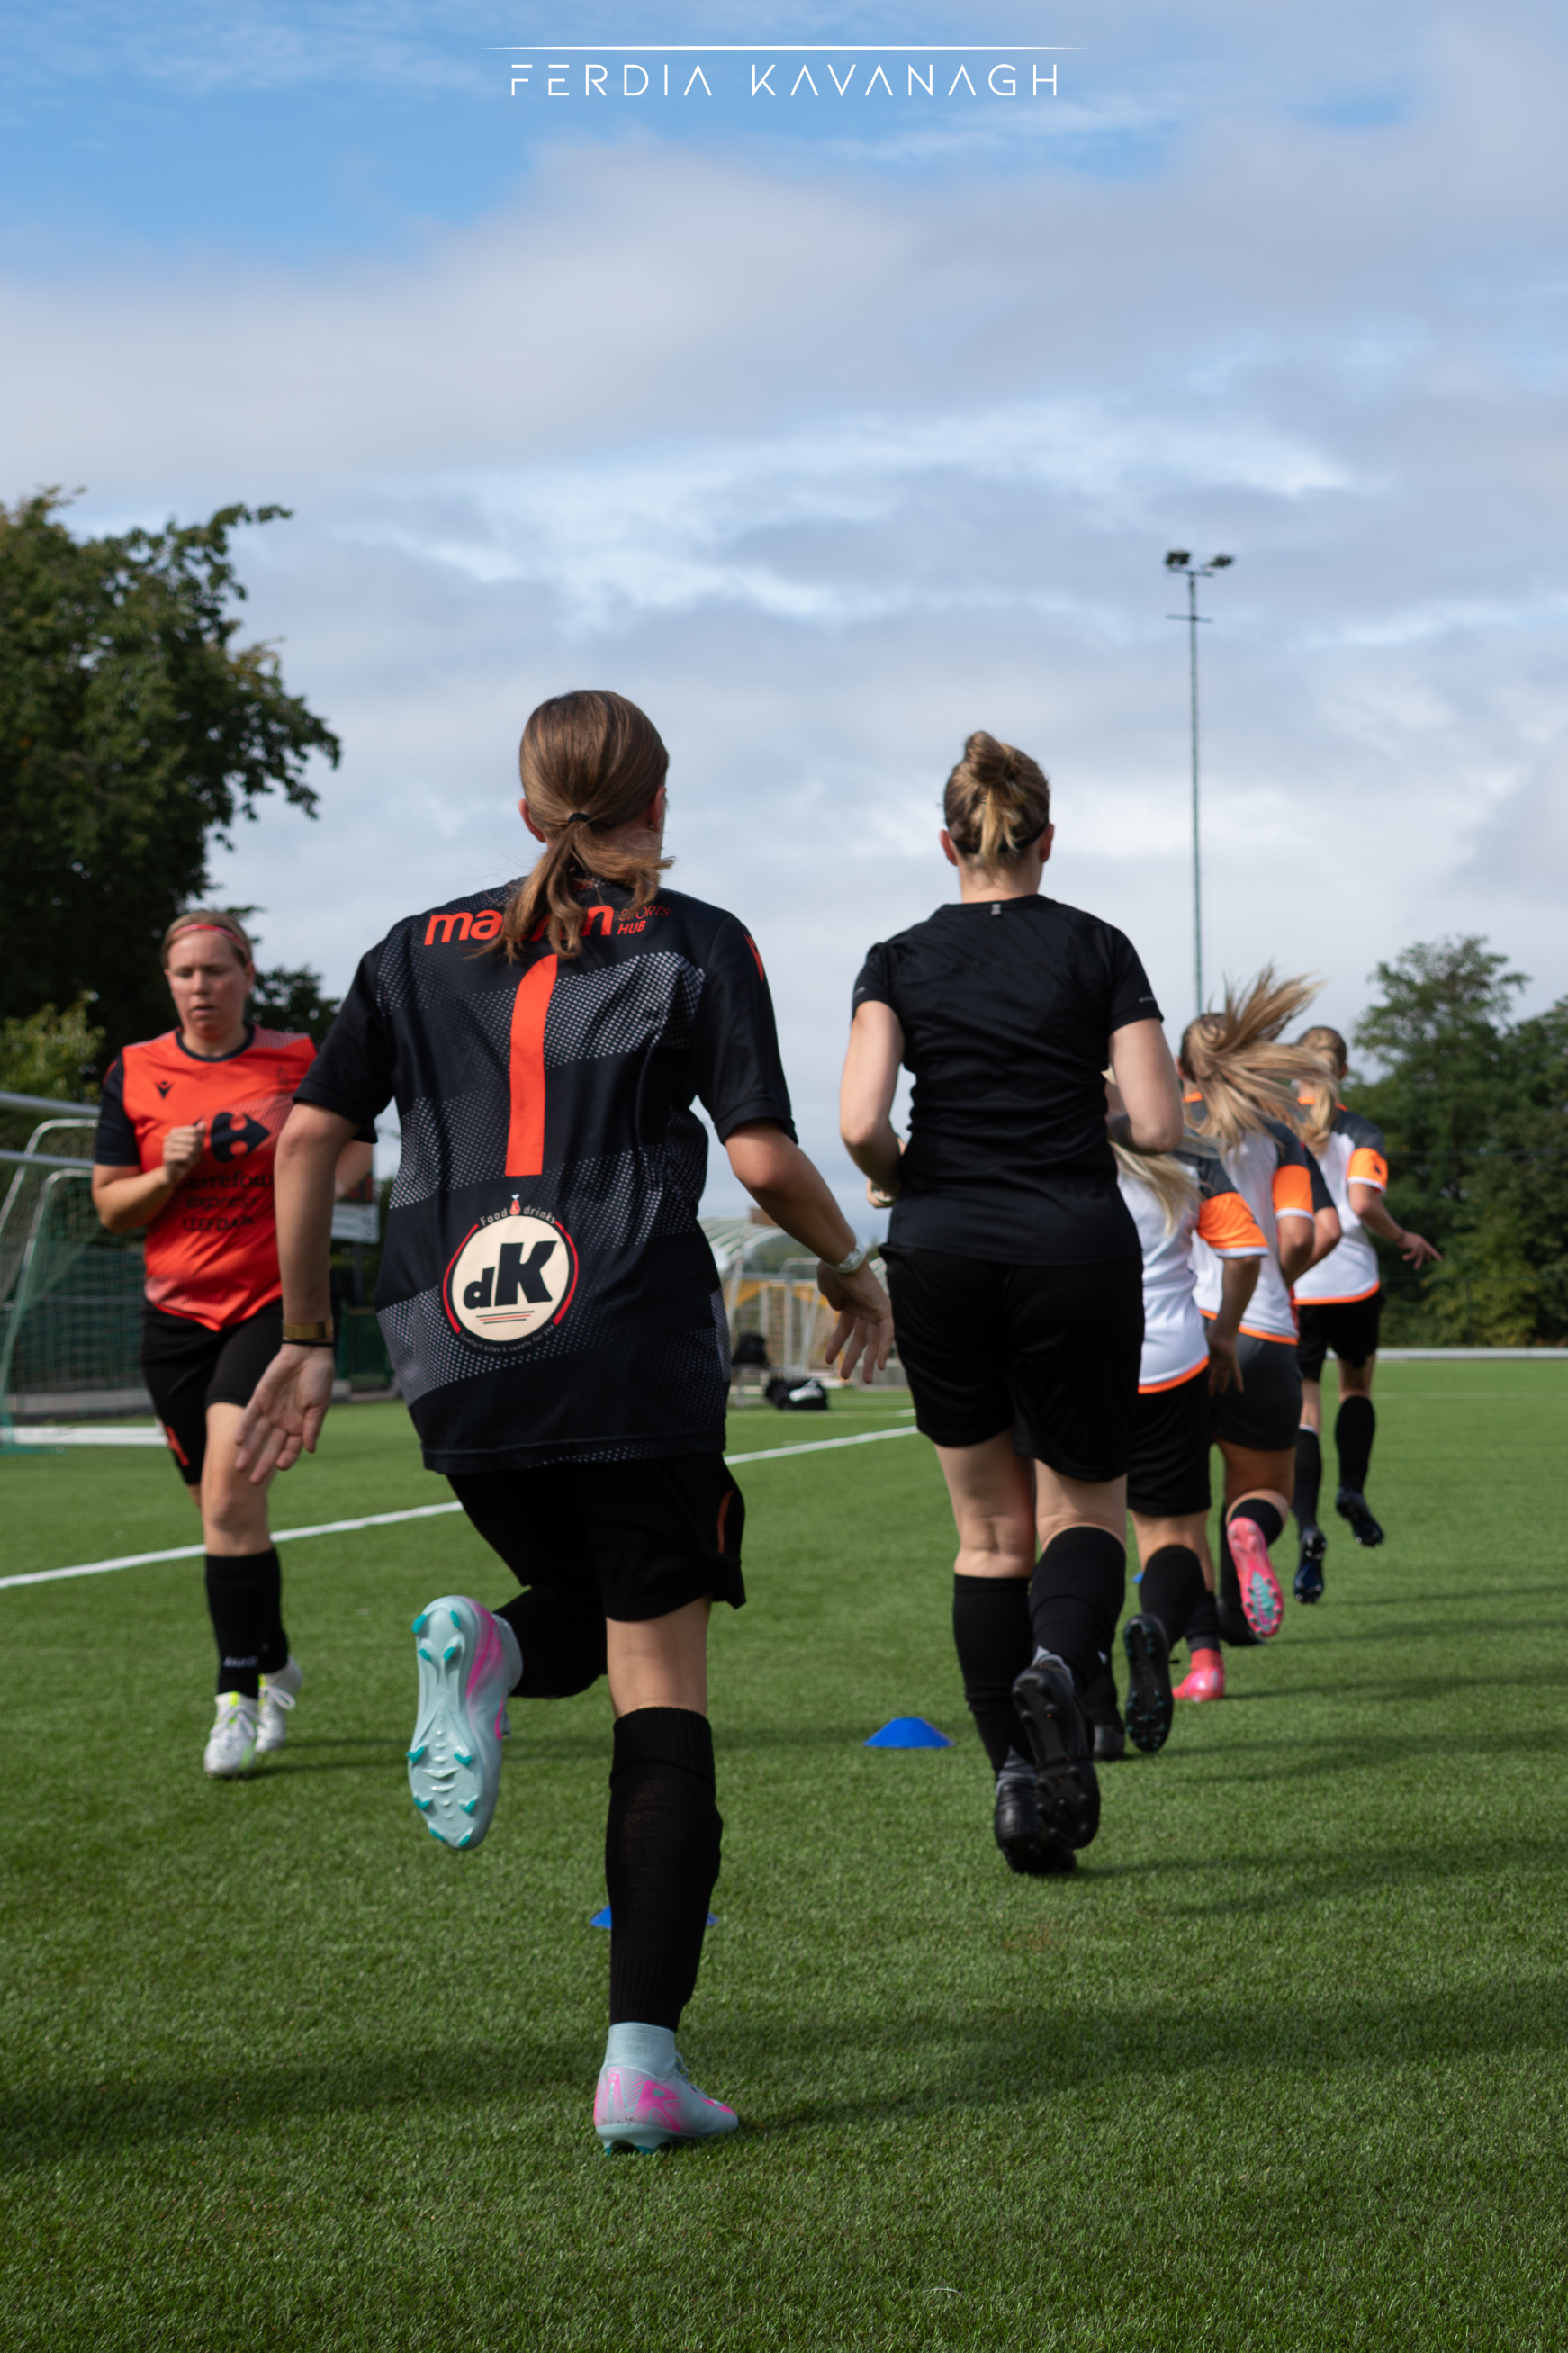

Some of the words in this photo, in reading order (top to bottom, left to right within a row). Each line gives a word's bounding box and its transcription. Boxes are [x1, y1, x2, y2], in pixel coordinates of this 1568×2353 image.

[423, 905, 614, 945] marn
[619, 906, 672, 922] SORTS
[617, 920, 647, 935] HUB
[504, 954, 559, 1176] 1
[175, 1169, 275, 1190] arrefou
[480, 1207, 509, 1226] Food
[522, 1204, 556, 1225] drinks
[463, 1240, 559, 1311] dK
